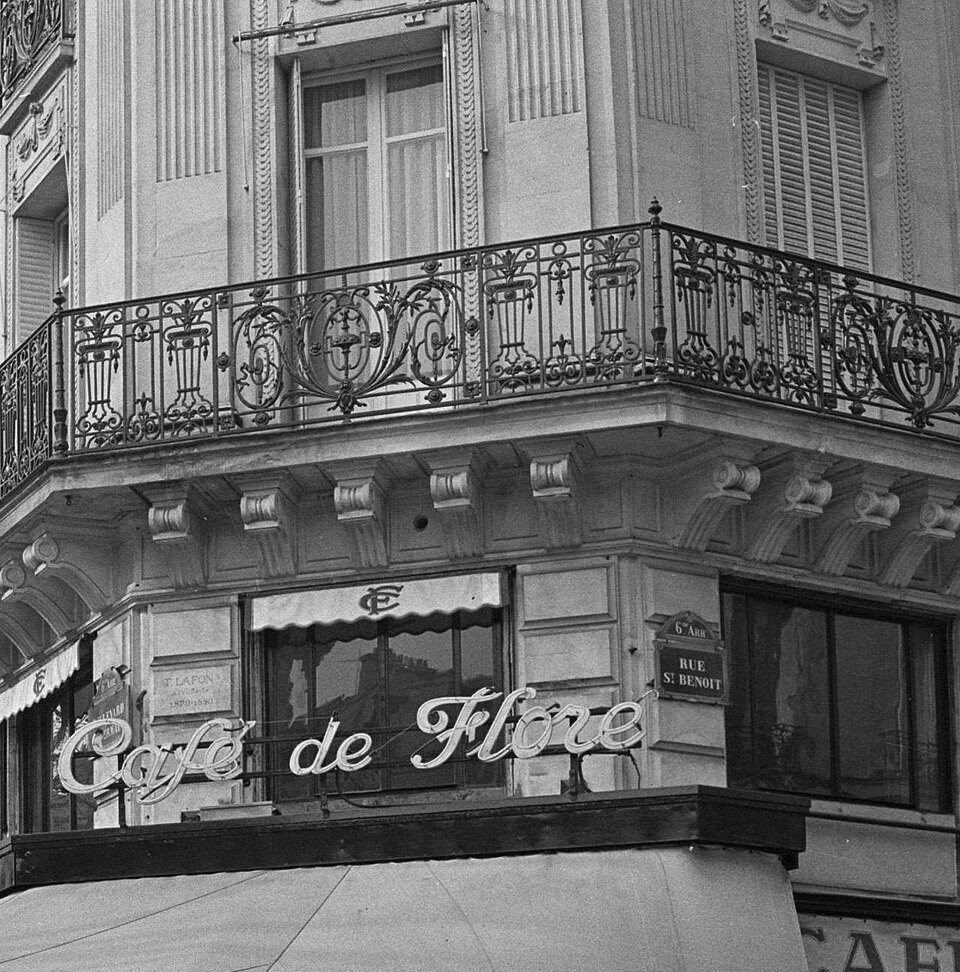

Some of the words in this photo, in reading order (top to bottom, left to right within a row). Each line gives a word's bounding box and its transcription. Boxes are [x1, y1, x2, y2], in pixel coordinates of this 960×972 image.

[679, 657, 706, 673] RUE
[679, 673, 722, 691] BENOIT
[58, 717, 257, 805] Café
[289, 711, 373, 776] de
[411, 686, 647, 770] Flore
